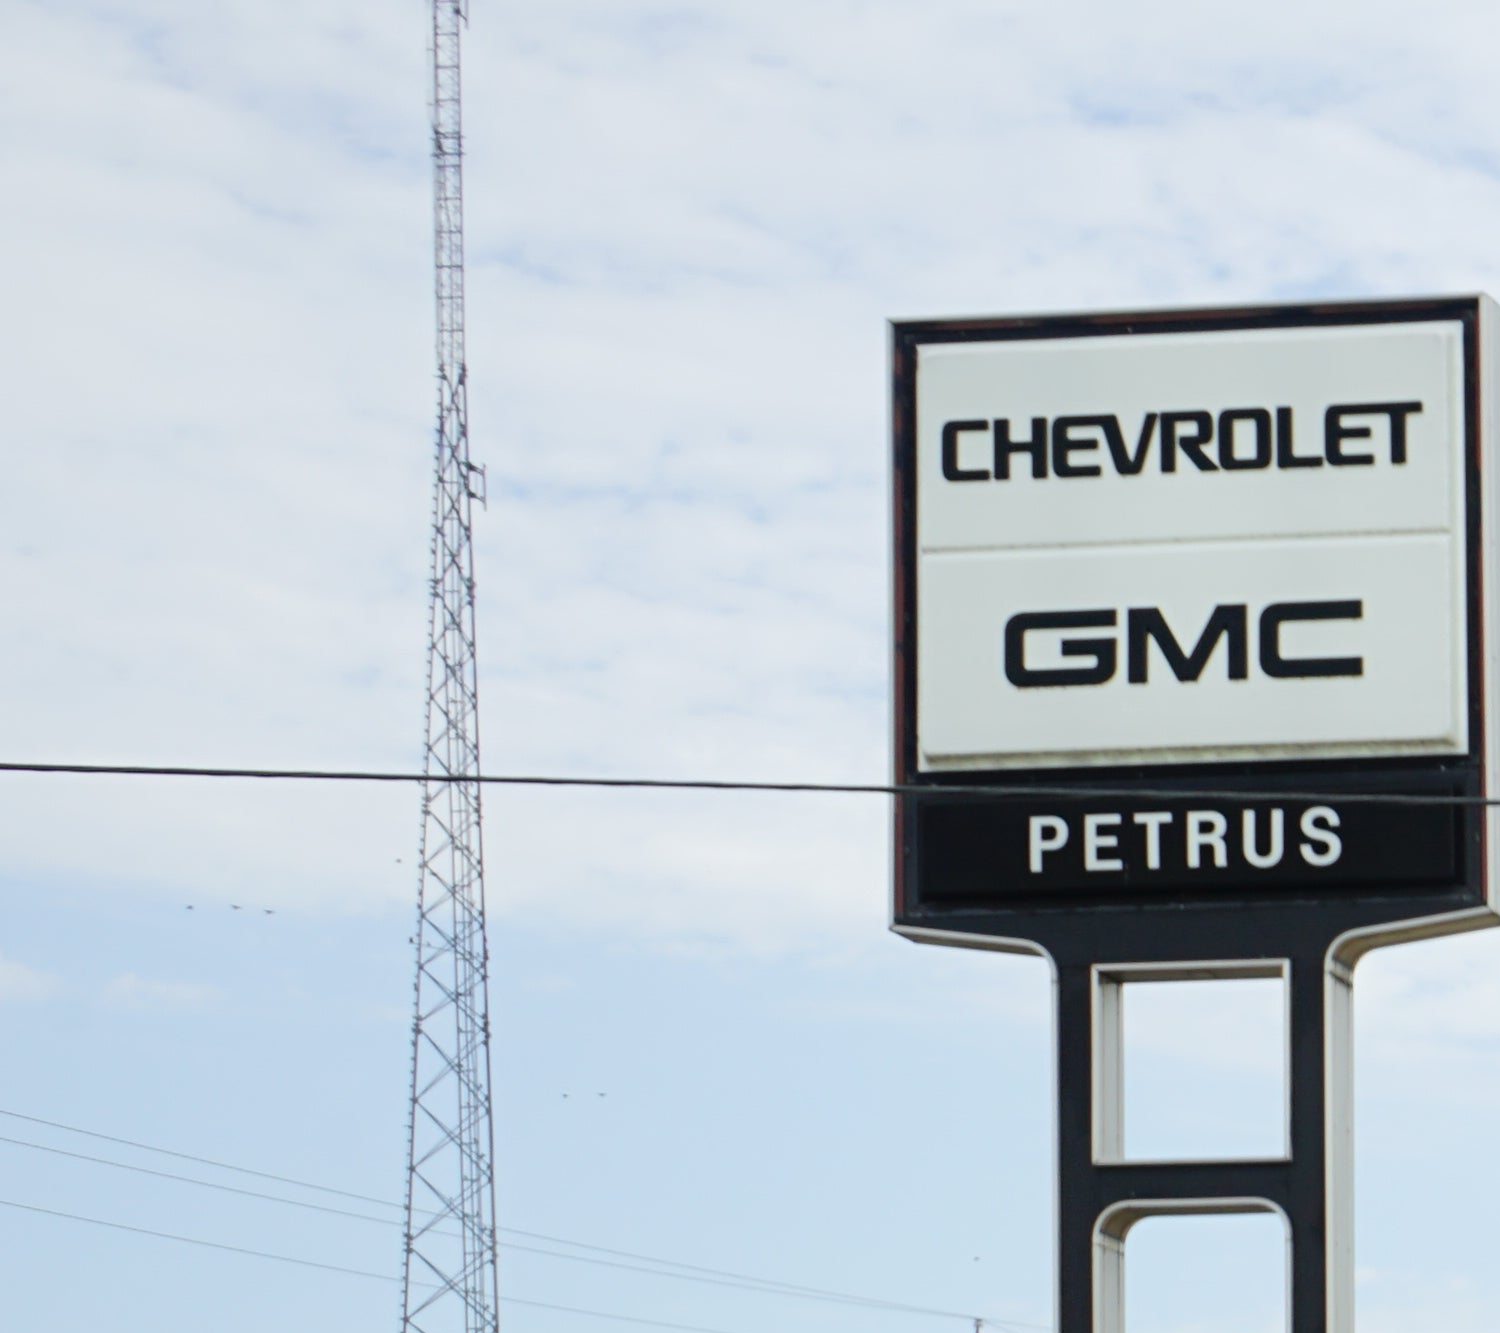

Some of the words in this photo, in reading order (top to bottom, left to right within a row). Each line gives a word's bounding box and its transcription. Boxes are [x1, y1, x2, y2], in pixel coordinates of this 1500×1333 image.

[941, 401, 1422, 482] CHEVROLET
[1004, 599, 1363, 687] GMC
[1028, 806, 1343, 873] PETRUS
